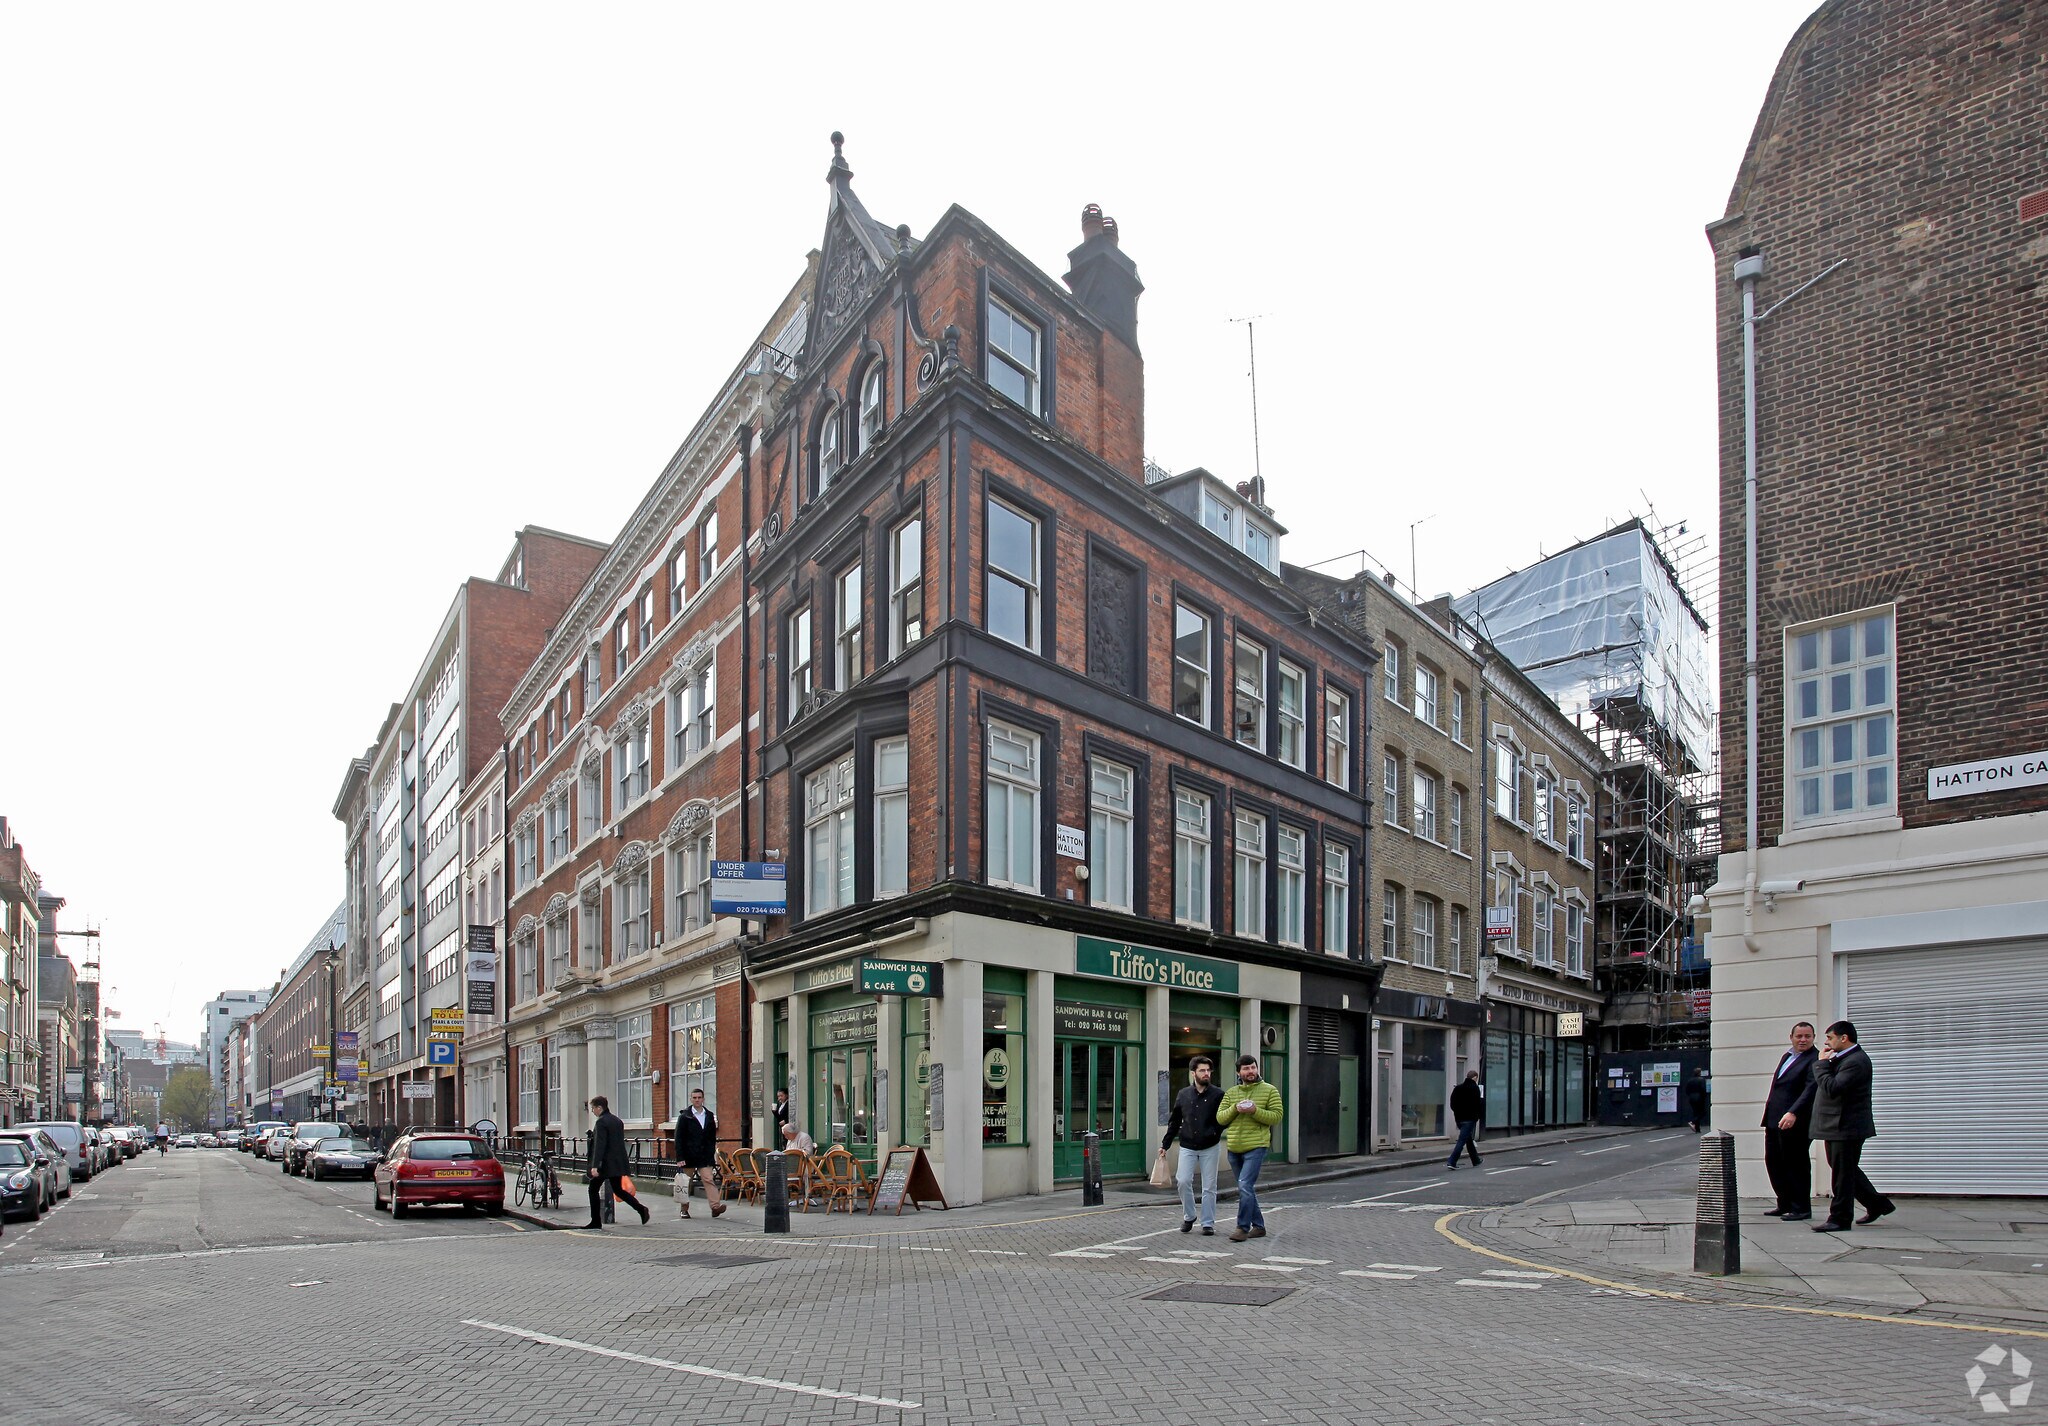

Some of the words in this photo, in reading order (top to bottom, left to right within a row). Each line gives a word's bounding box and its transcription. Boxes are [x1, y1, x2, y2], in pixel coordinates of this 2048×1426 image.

[1936, 765, 2013, 788] HATTON
[1058, 834, 1083, 847] HATTON
[1057, 843, 1075, 855] WALL
[717, 870, 744, 878] OFFER
[863, 961, 907, 972] SANDWICH
[911, 964, 928, 973] BAR
[1110, 950, 1168, 983] Tuffo's
[1171, 961, 1214, 989] Place
[874, 981, 896, 991] CAFÉ
[1055, 1005, 1090, 1017] SANDWICH
[1092, 1009, 1105, 1018] BAR
[1107, 1011, 1112, 1019] &
[818, 1013, 847, 1027] SANDWICH
[848, 1011, 860, 1022] BAR
[1064, 1020, 1076, 1028] Tel:
[1079, 1021, 1090, 1030] 020
[1092, 1022, 1106, 1031] 7405
[1108, 1024, 1121, 1032] 5108
[434, 1044, 450, 1062] P
